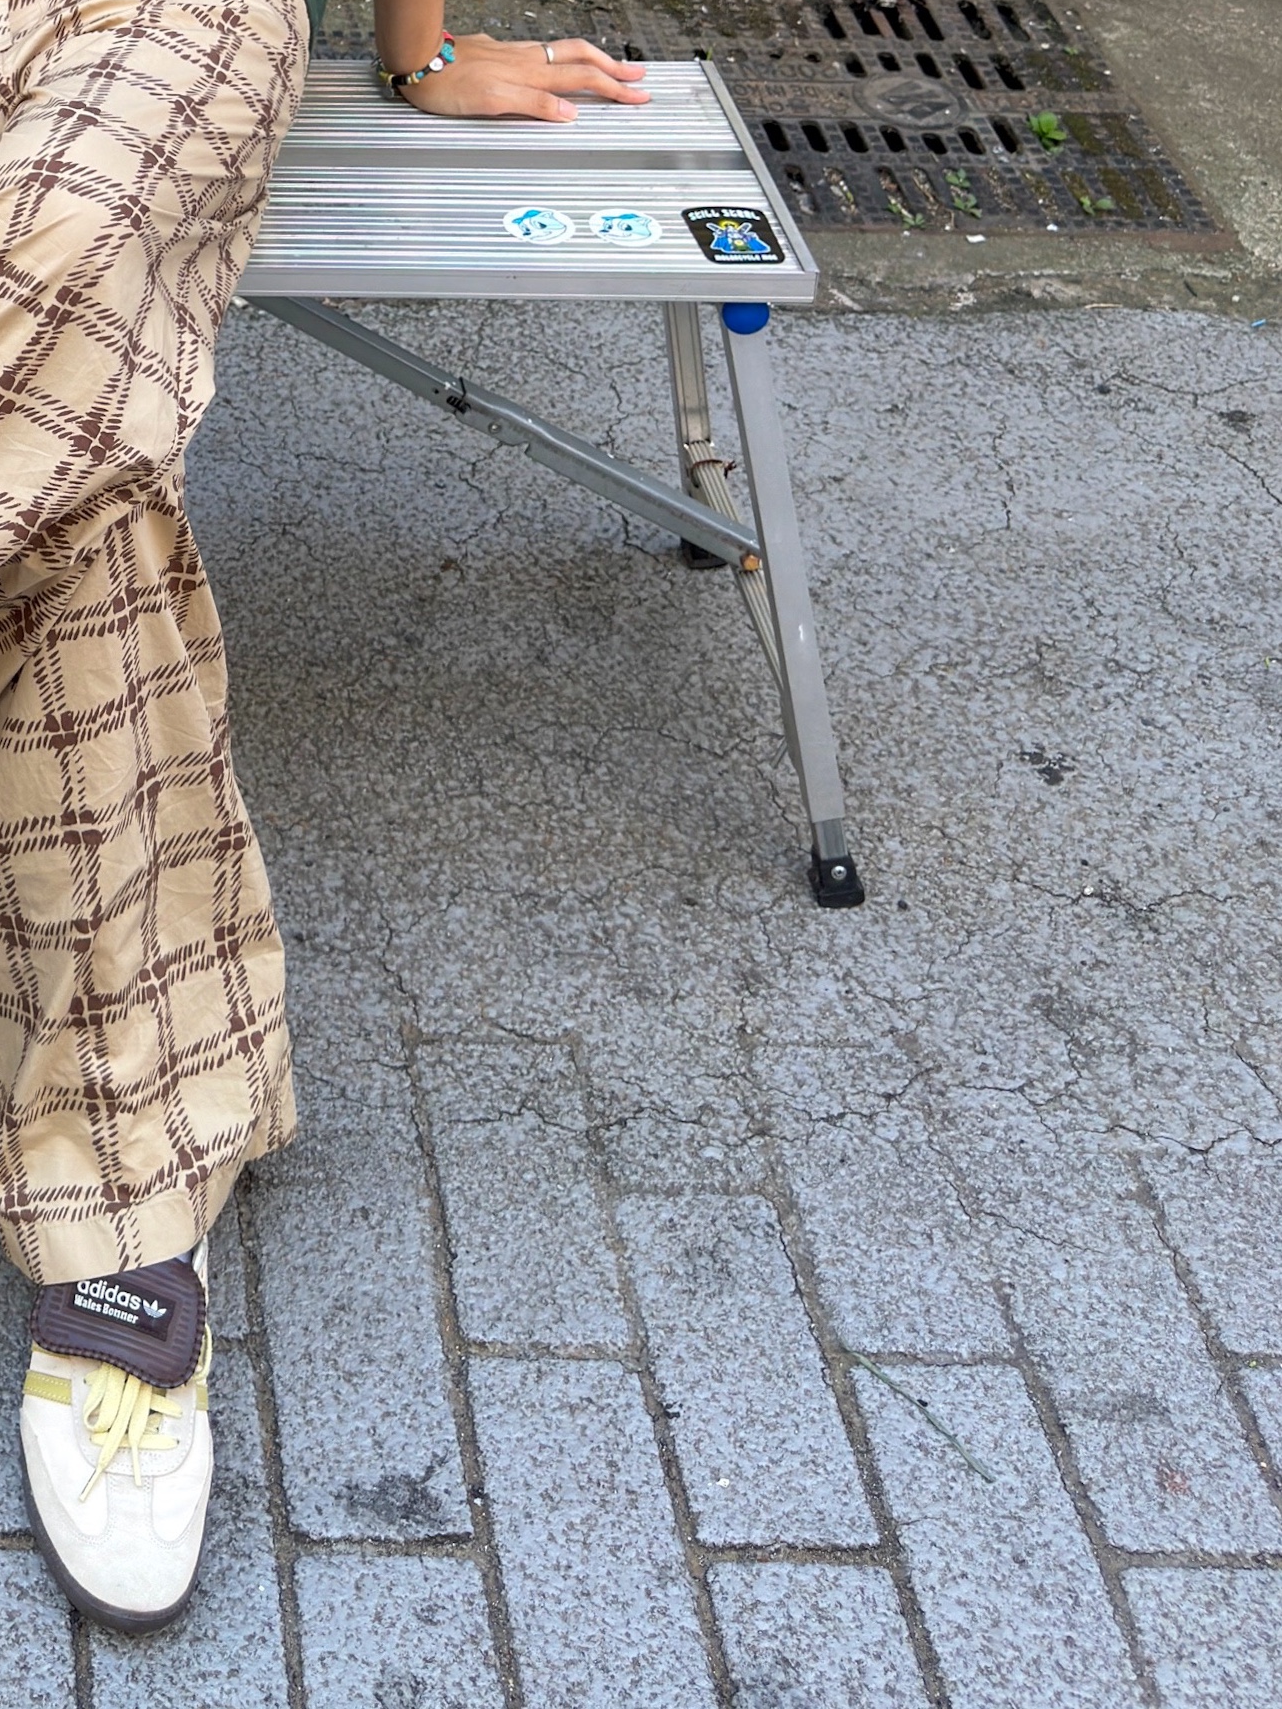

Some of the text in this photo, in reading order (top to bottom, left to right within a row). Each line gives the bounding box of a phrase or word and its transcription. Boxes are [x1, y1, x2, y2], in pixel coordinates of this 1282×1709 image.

[74, 1293, 139, 1324] Wales Bonner
[77, 1279, 142, 1311] adidas
